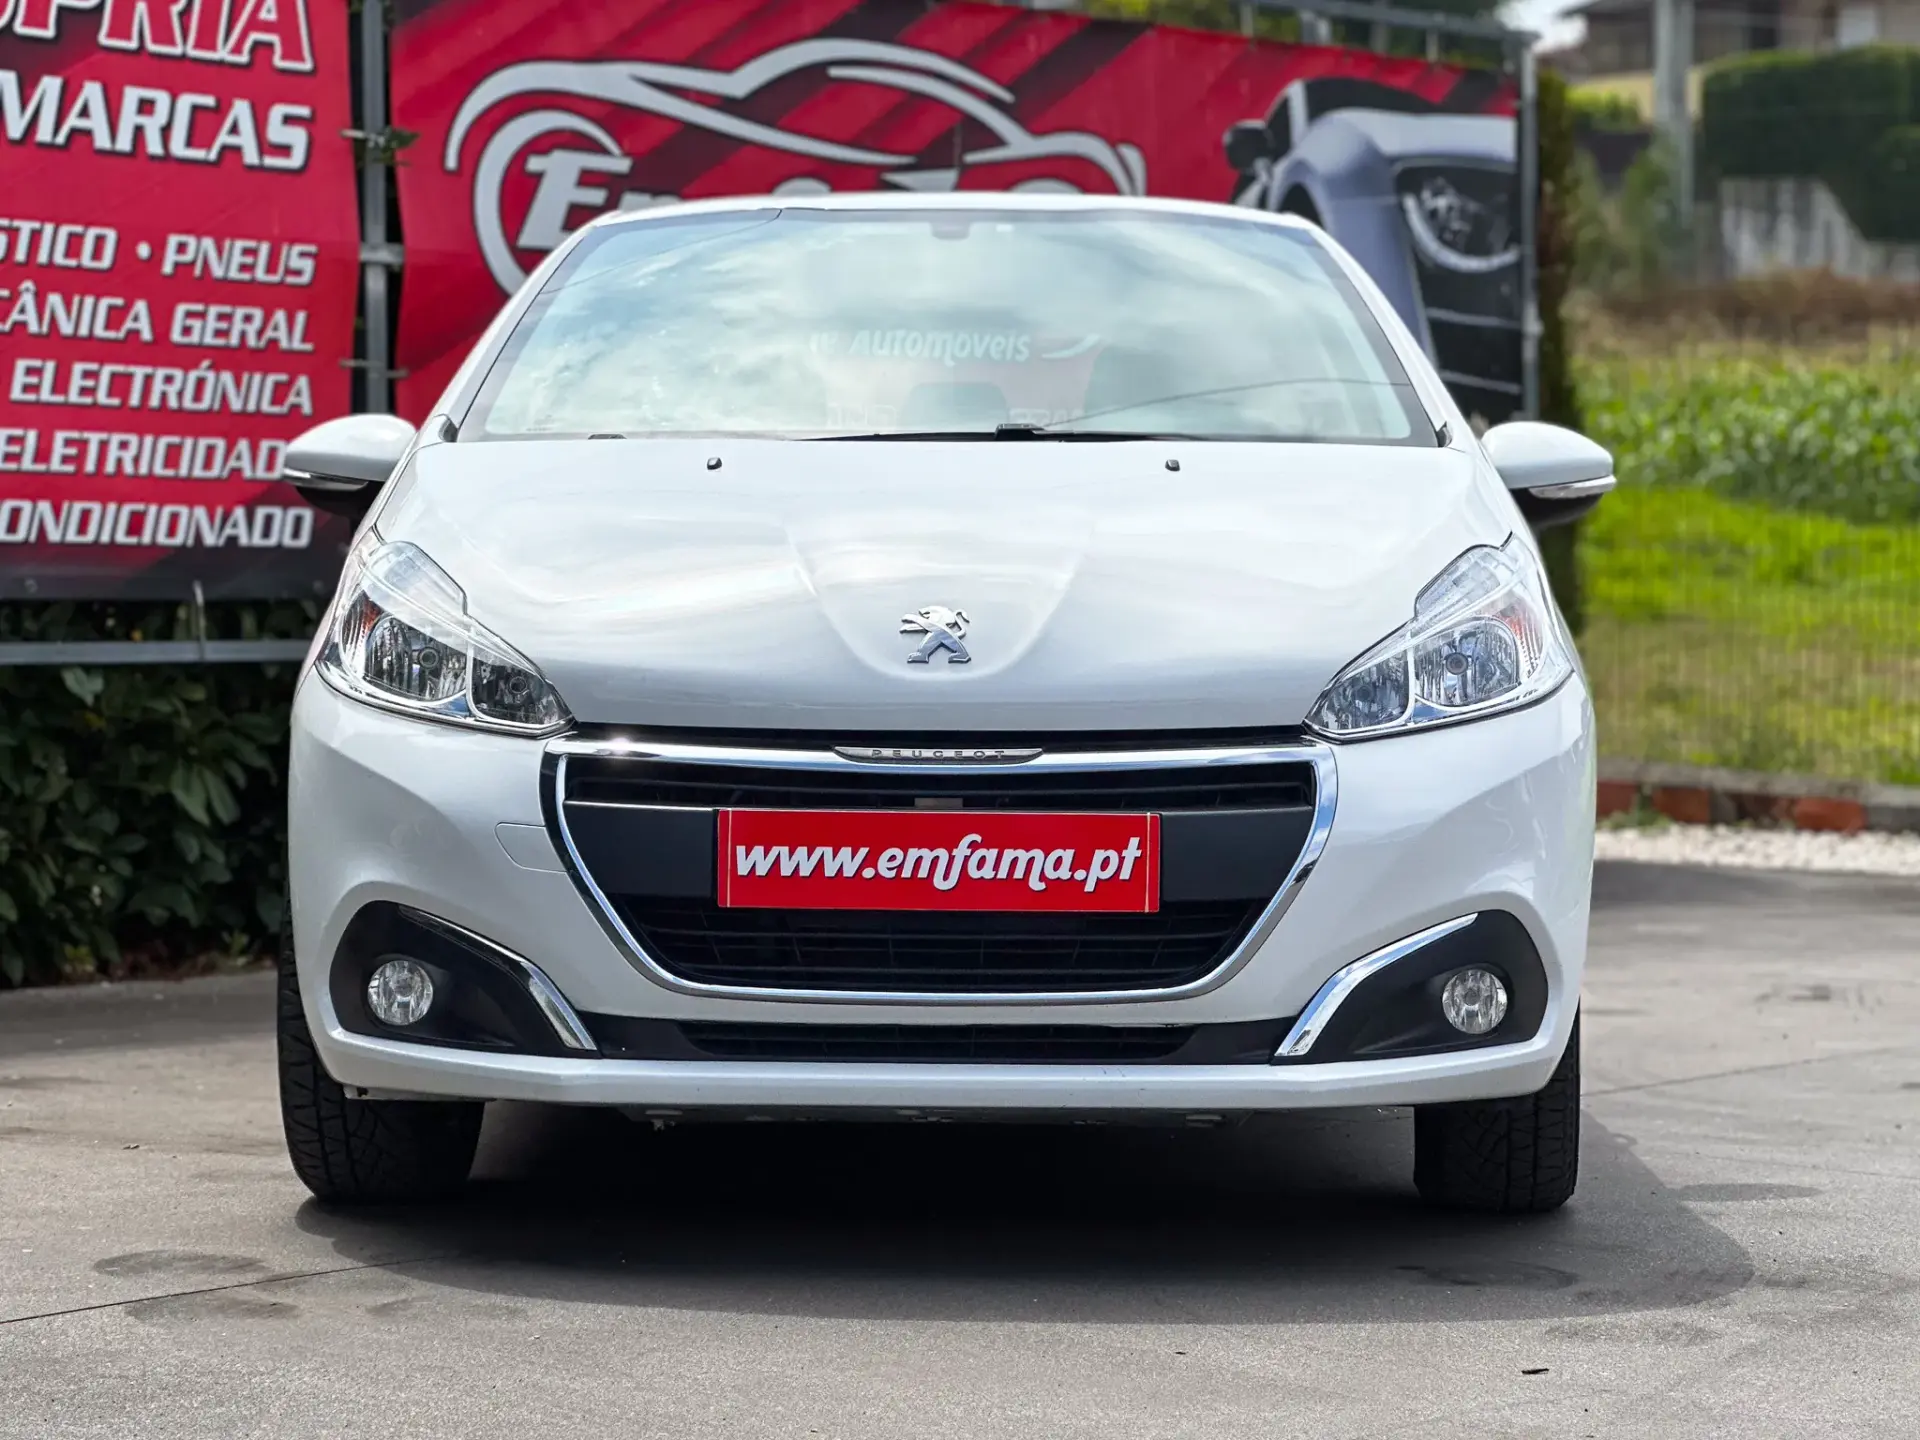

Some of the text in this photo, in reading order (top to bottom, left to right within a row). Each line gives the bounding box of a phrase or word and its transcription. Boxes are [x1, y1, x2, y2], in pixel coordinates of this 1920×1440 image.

[161, 233, 317, 285] PNEUS
[170, 302, 314, 351] GERAL
[9, 358, 312, 415] ELECTRÓNICA
[871, 749, 1005, 759] PEUGEOT
[736, 833, 1142, 892] www.emfama.pt
